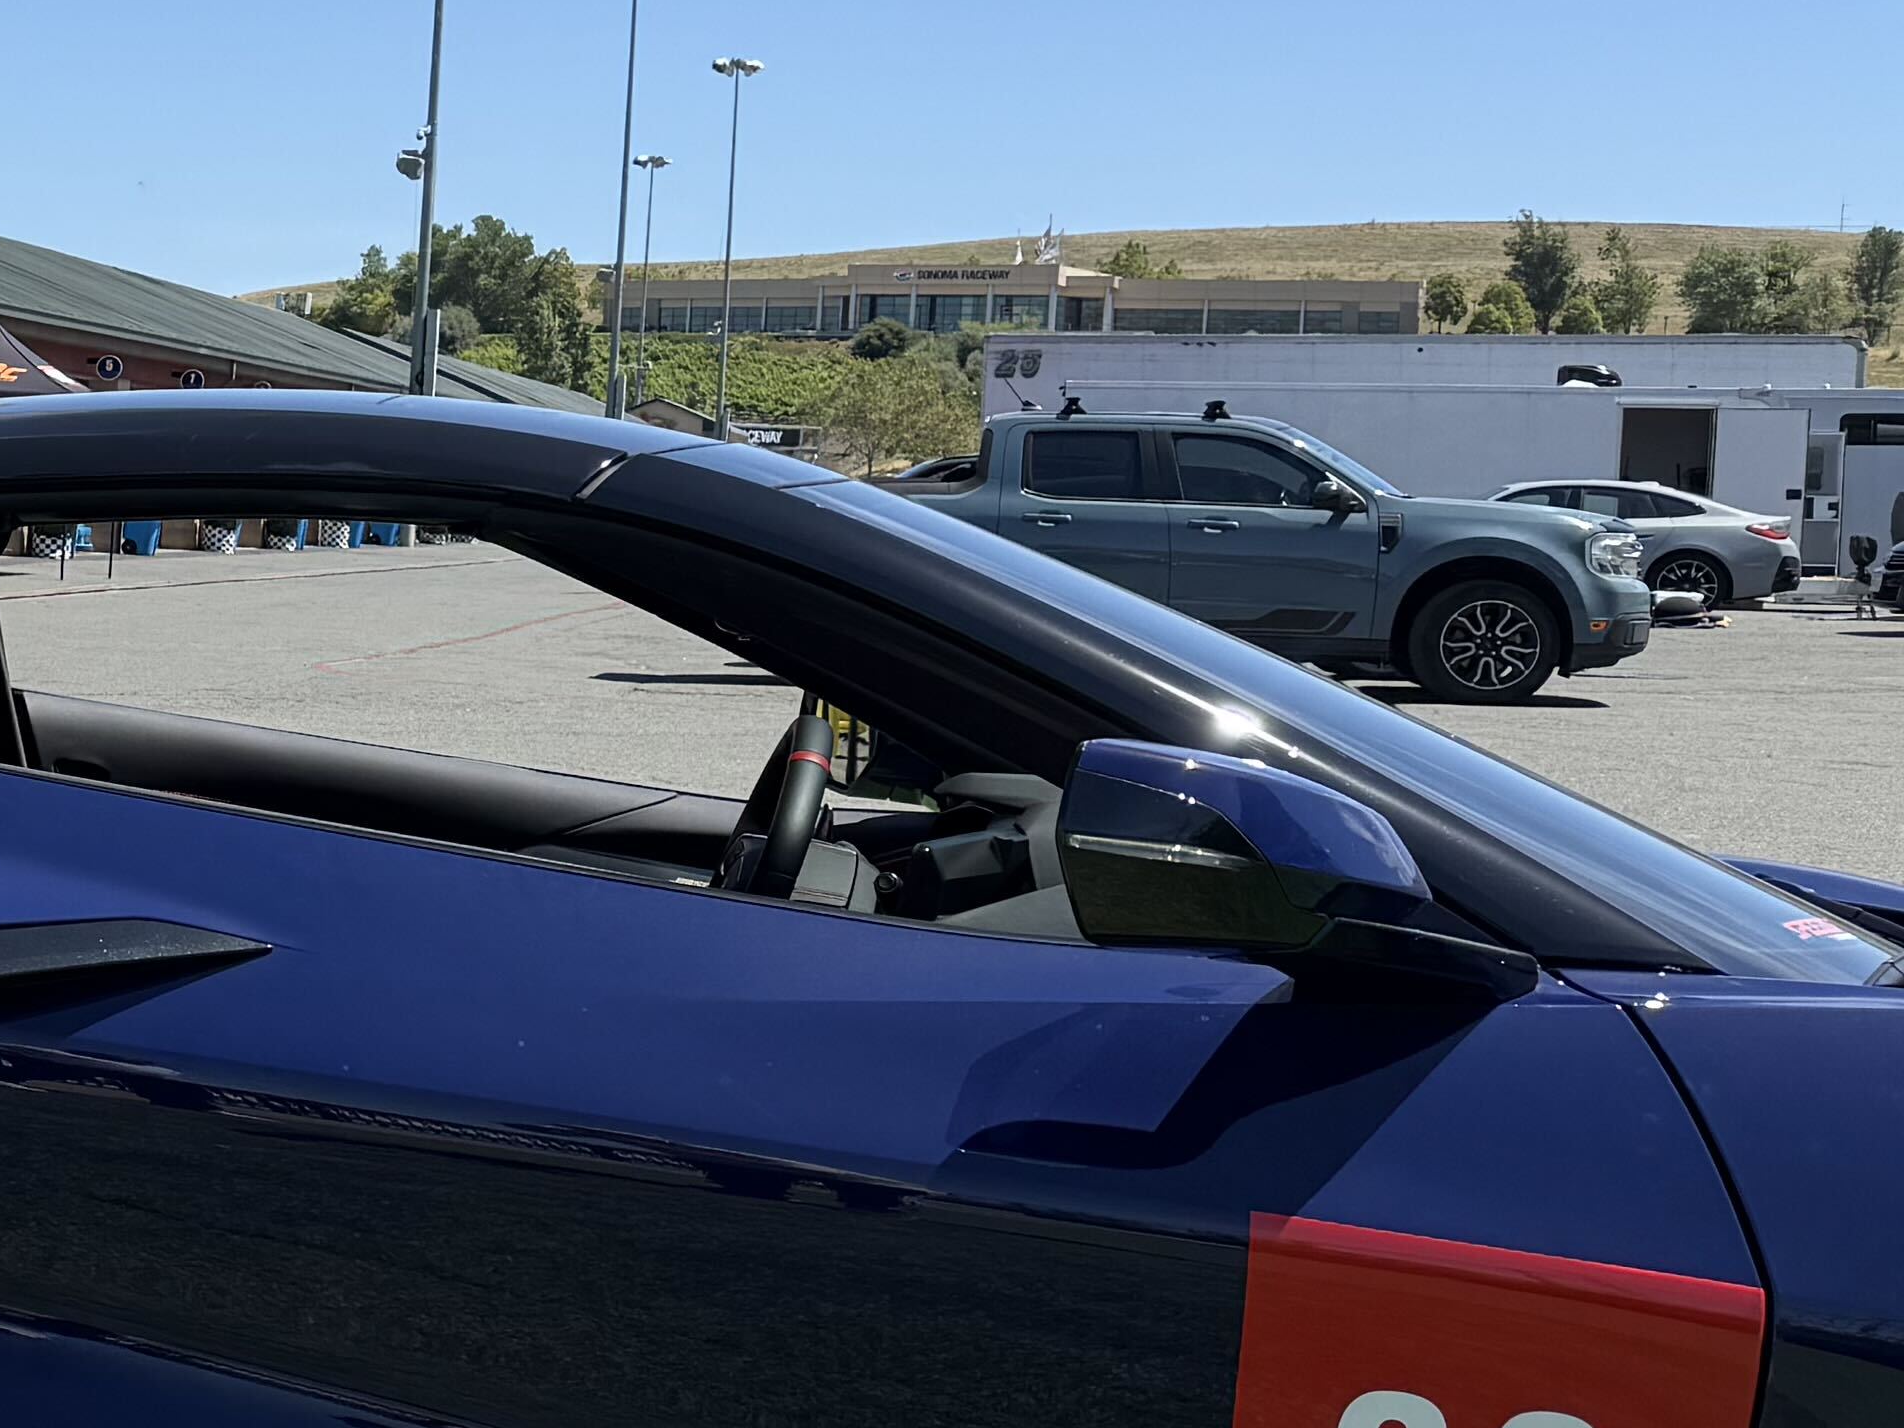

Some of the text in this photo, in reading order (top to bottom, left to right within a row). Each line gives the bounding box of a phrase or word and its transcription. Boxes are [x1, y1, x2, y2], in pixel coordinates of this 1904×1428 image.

[917, 270, 1010, 279] SONOMA RACEWAY
[747, 429, 783, 444] CEWAY
